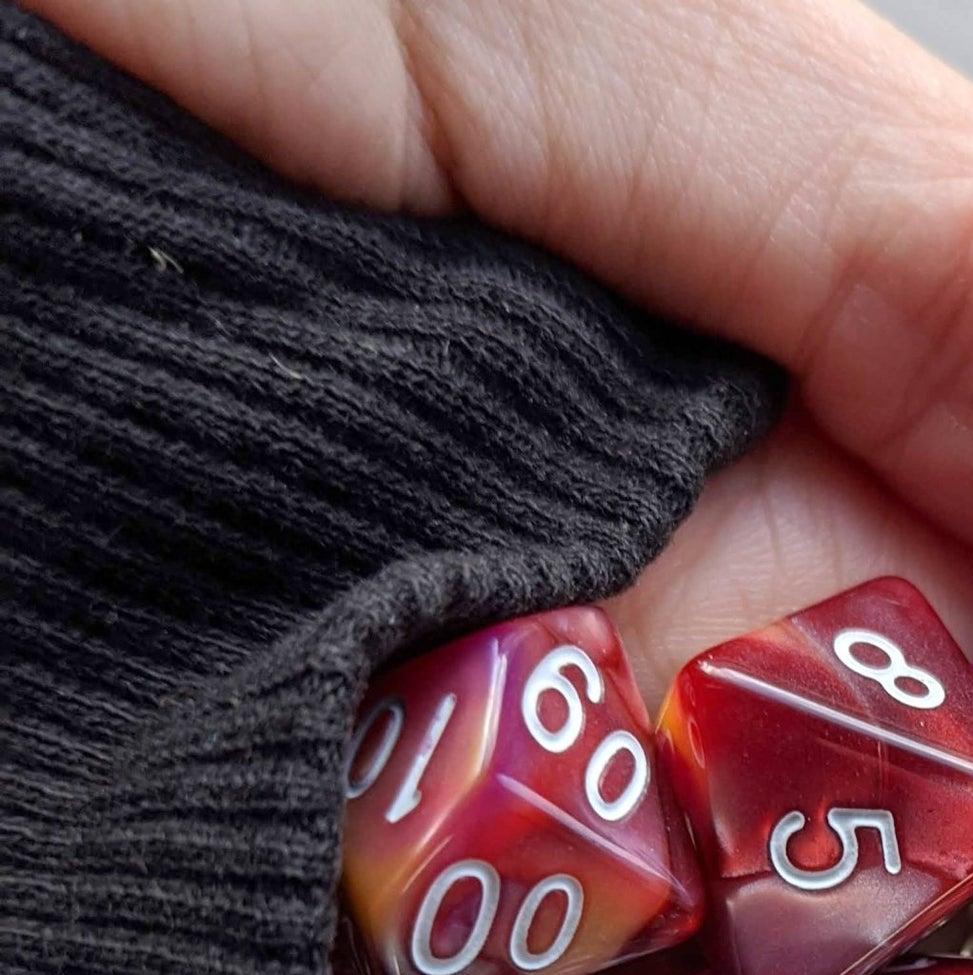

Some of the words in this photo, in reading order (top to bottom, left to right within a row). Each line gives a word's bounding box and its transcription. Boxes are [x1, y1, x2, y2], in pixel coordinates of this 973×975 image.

[833, 628, 946, 709] 8
[521, 645, 650, 821] 60
[769, 807, 902, 890] 5
